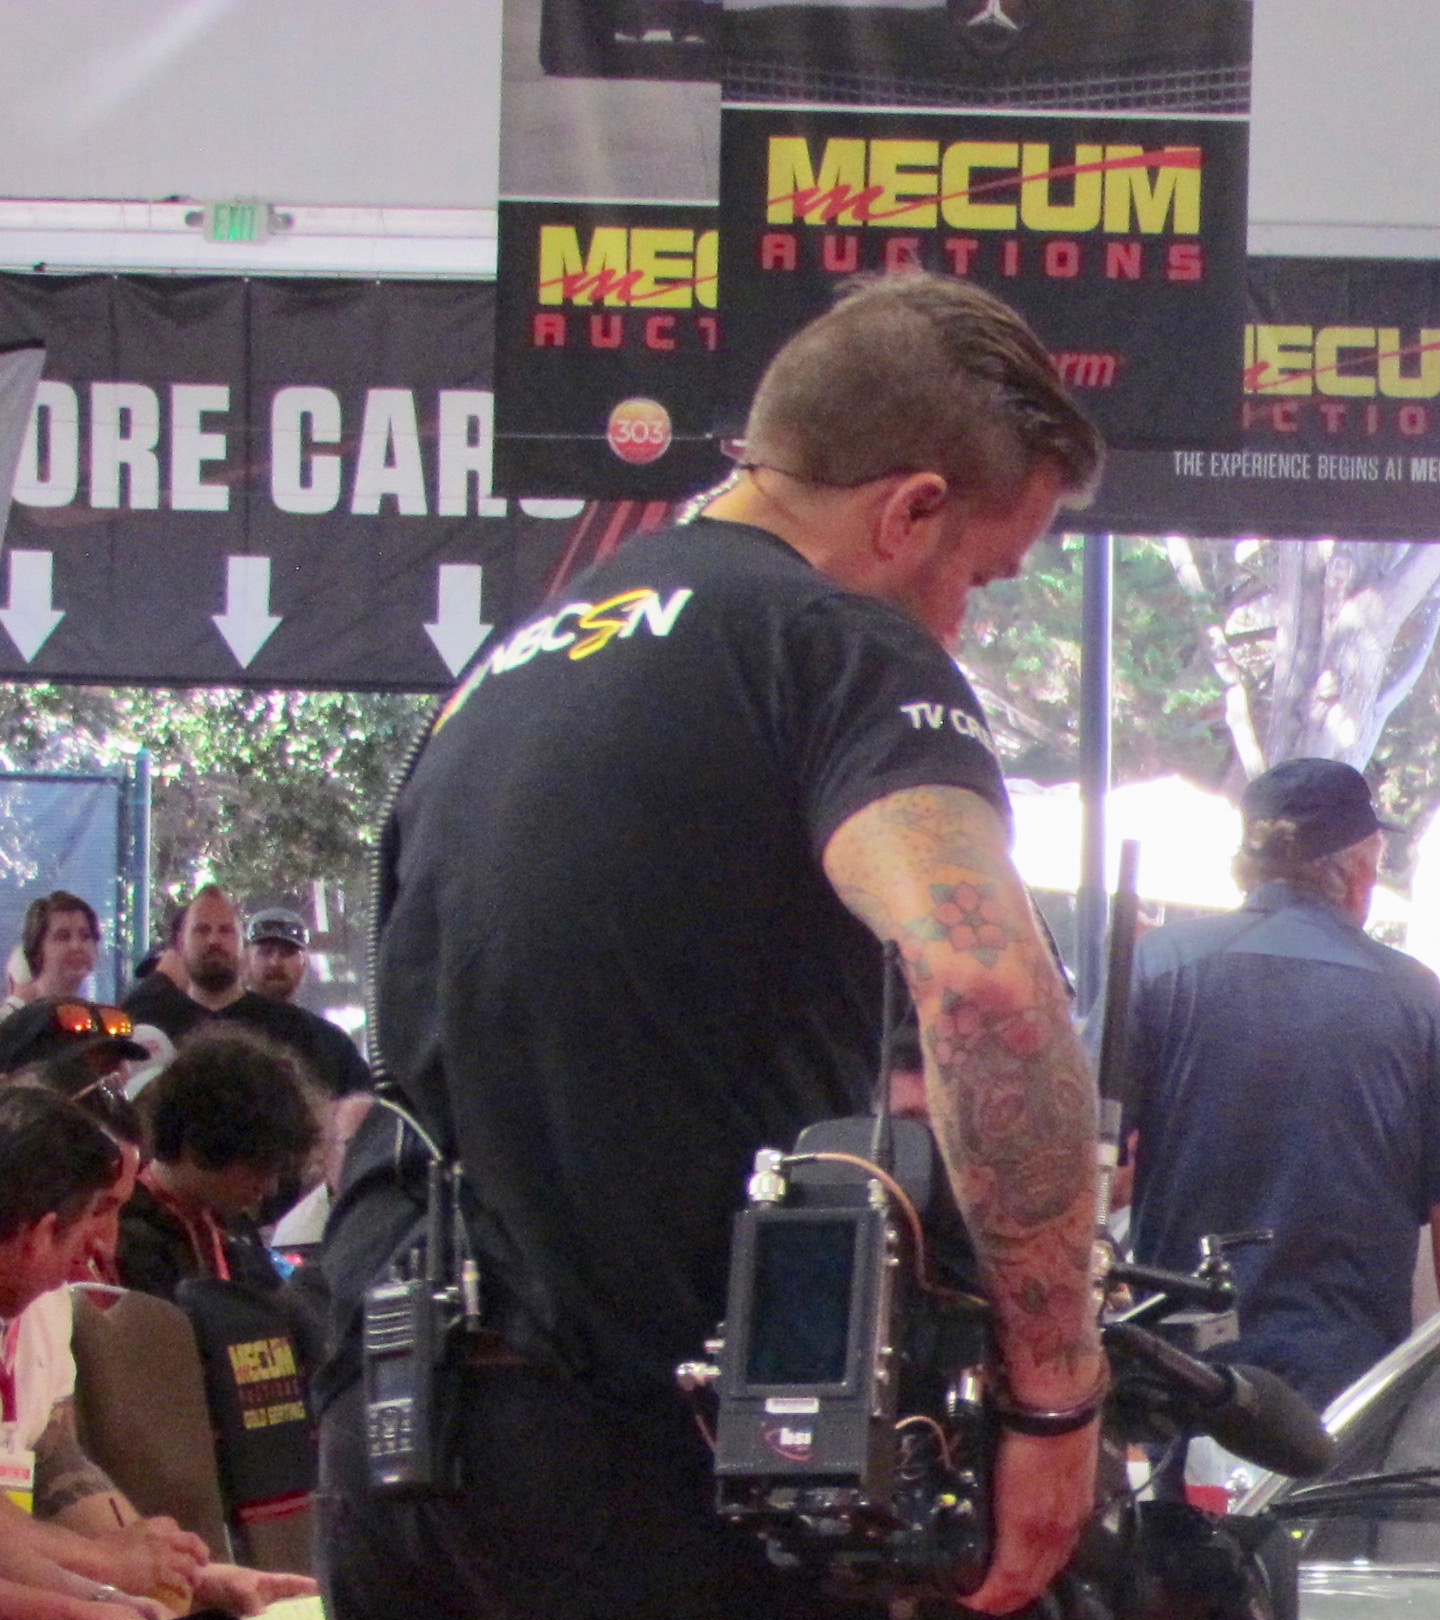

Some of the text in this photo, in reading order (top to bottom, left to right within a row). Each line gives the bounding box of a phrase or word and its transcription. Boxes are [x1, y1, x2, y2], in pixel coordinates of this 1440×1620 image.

[767, 136, 1203, 234] MECUM
[761, 234, 1201, 281] AUCTIONS
[11, 380, 587, 519] ORE CAR
[614, 418, 663, 443] 303
[1174, 450, 1204, 477] THE
[1210, 452, 1312, 480] EXPERIENCE
[1318, 454, 1379, 481] BEGINS
[899, 701, 945, 730] TV
